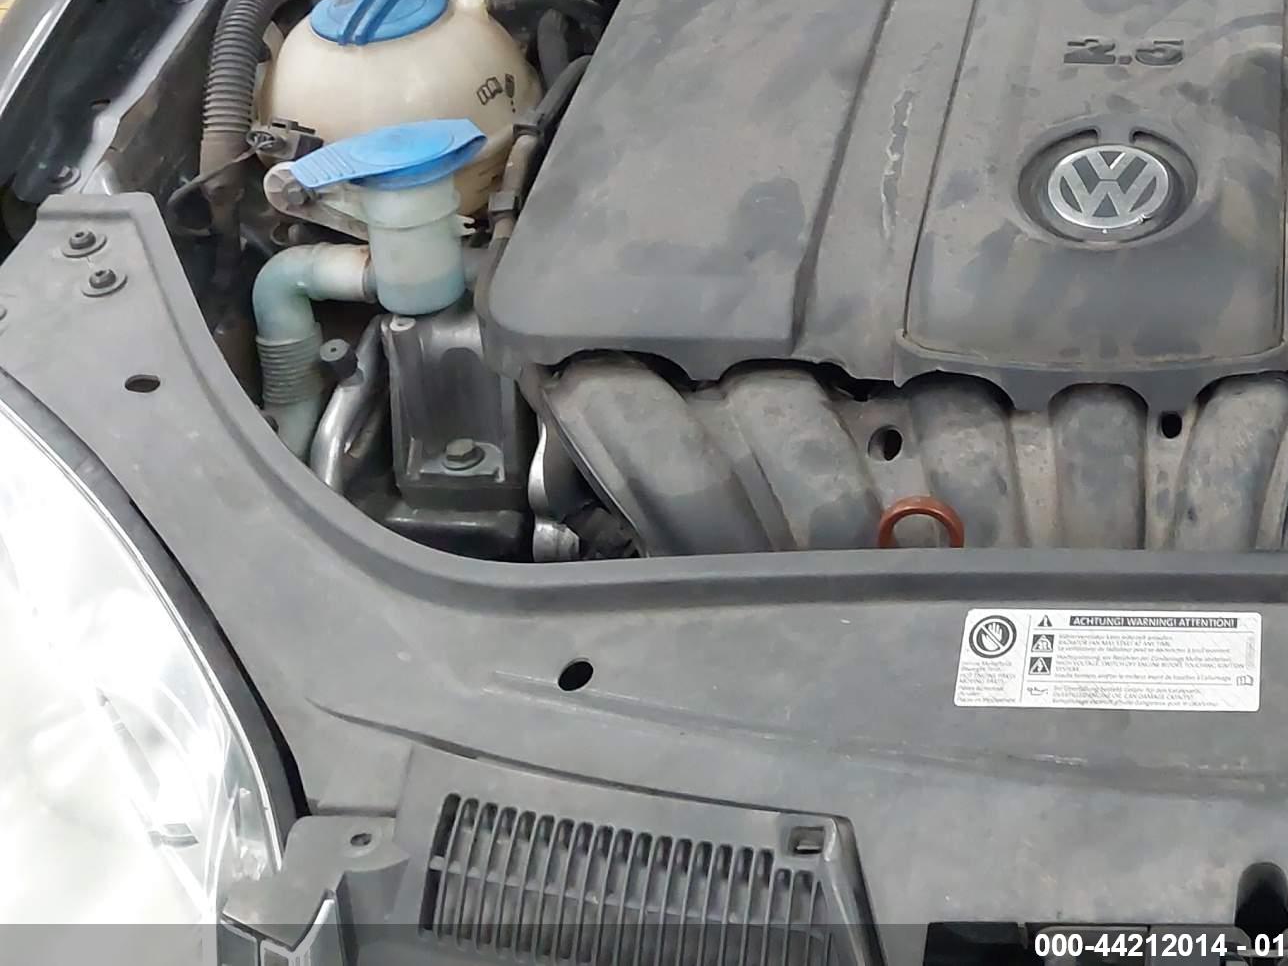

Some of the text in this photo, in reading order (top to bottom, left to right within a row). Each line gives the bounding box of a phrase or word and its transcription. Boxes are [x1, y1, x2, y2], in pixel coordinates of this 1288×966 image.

[1063, 38, 1184, 66] 2.5
[1073, 616, 1236, 628] ACHTUNG! WARNING! ATTENTION!
